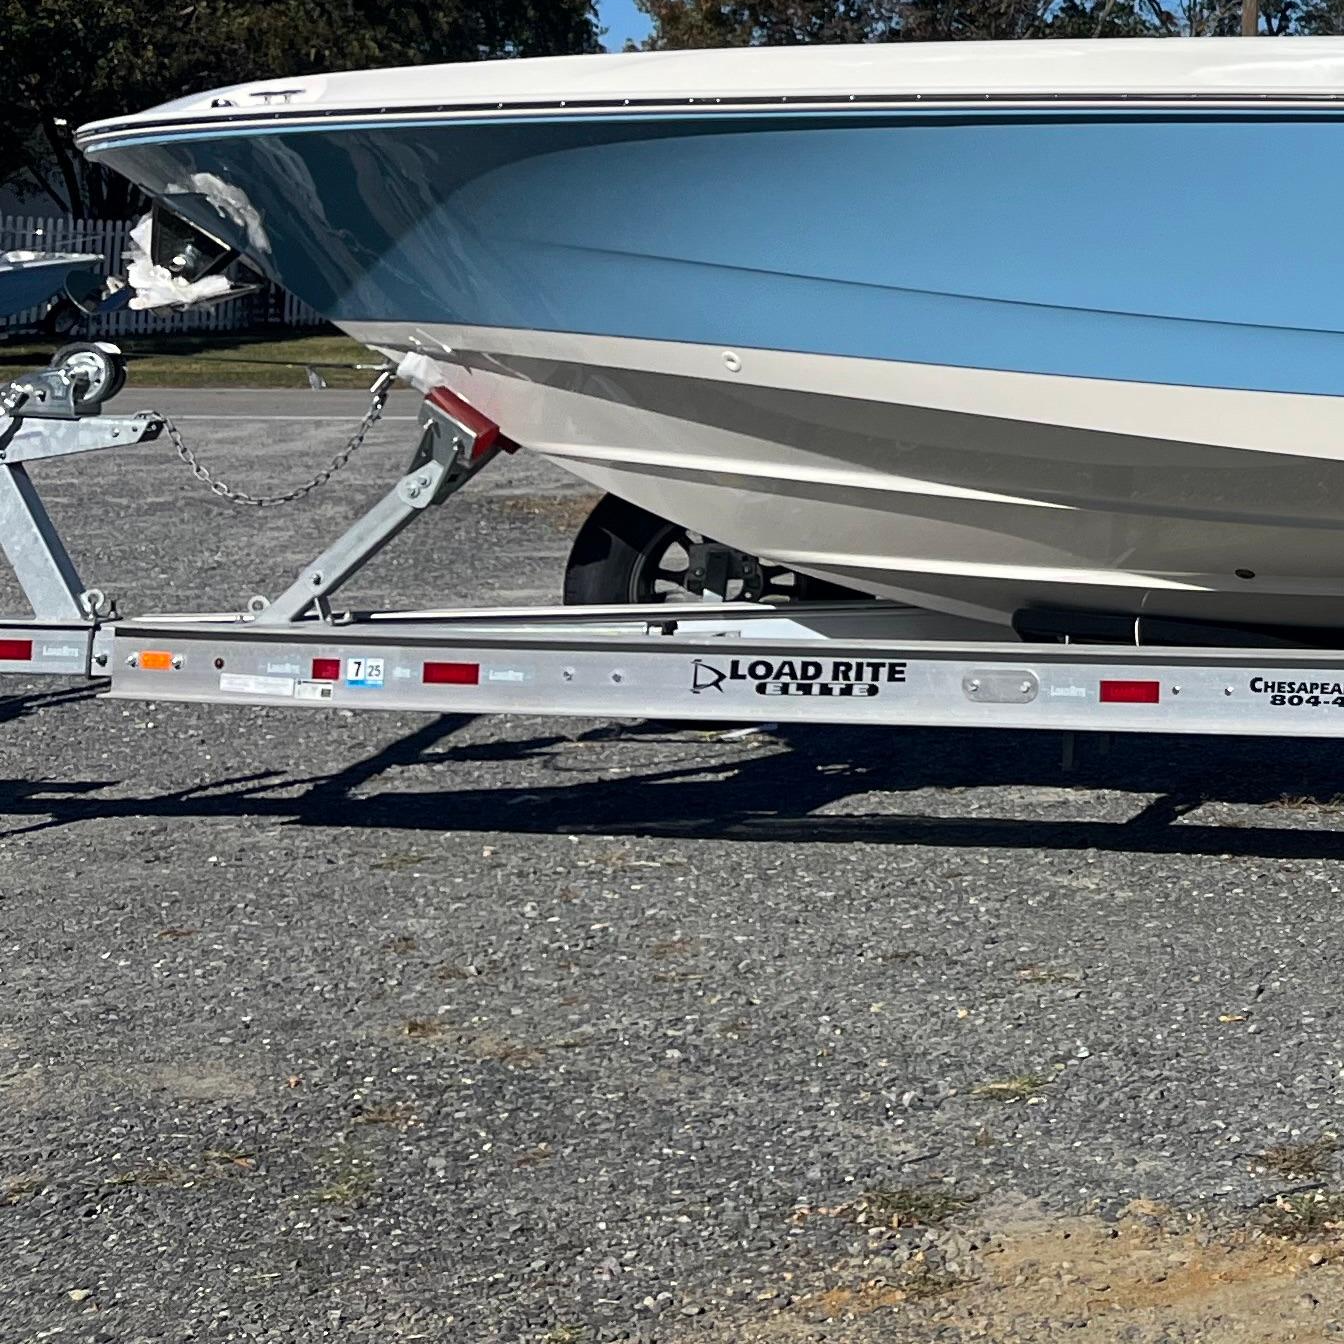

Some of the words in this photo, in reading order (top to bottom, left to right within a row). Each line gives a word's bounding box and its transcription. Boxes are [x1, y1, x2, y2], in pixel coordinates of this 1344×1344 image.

[353, 661, 362, 677] 7
[368, 665, 381, 677] 25
[730, 659, 822, 681] LOAD
[832, 661, 907, 682] RITE
[765, 683, 869, 696] ELITE
